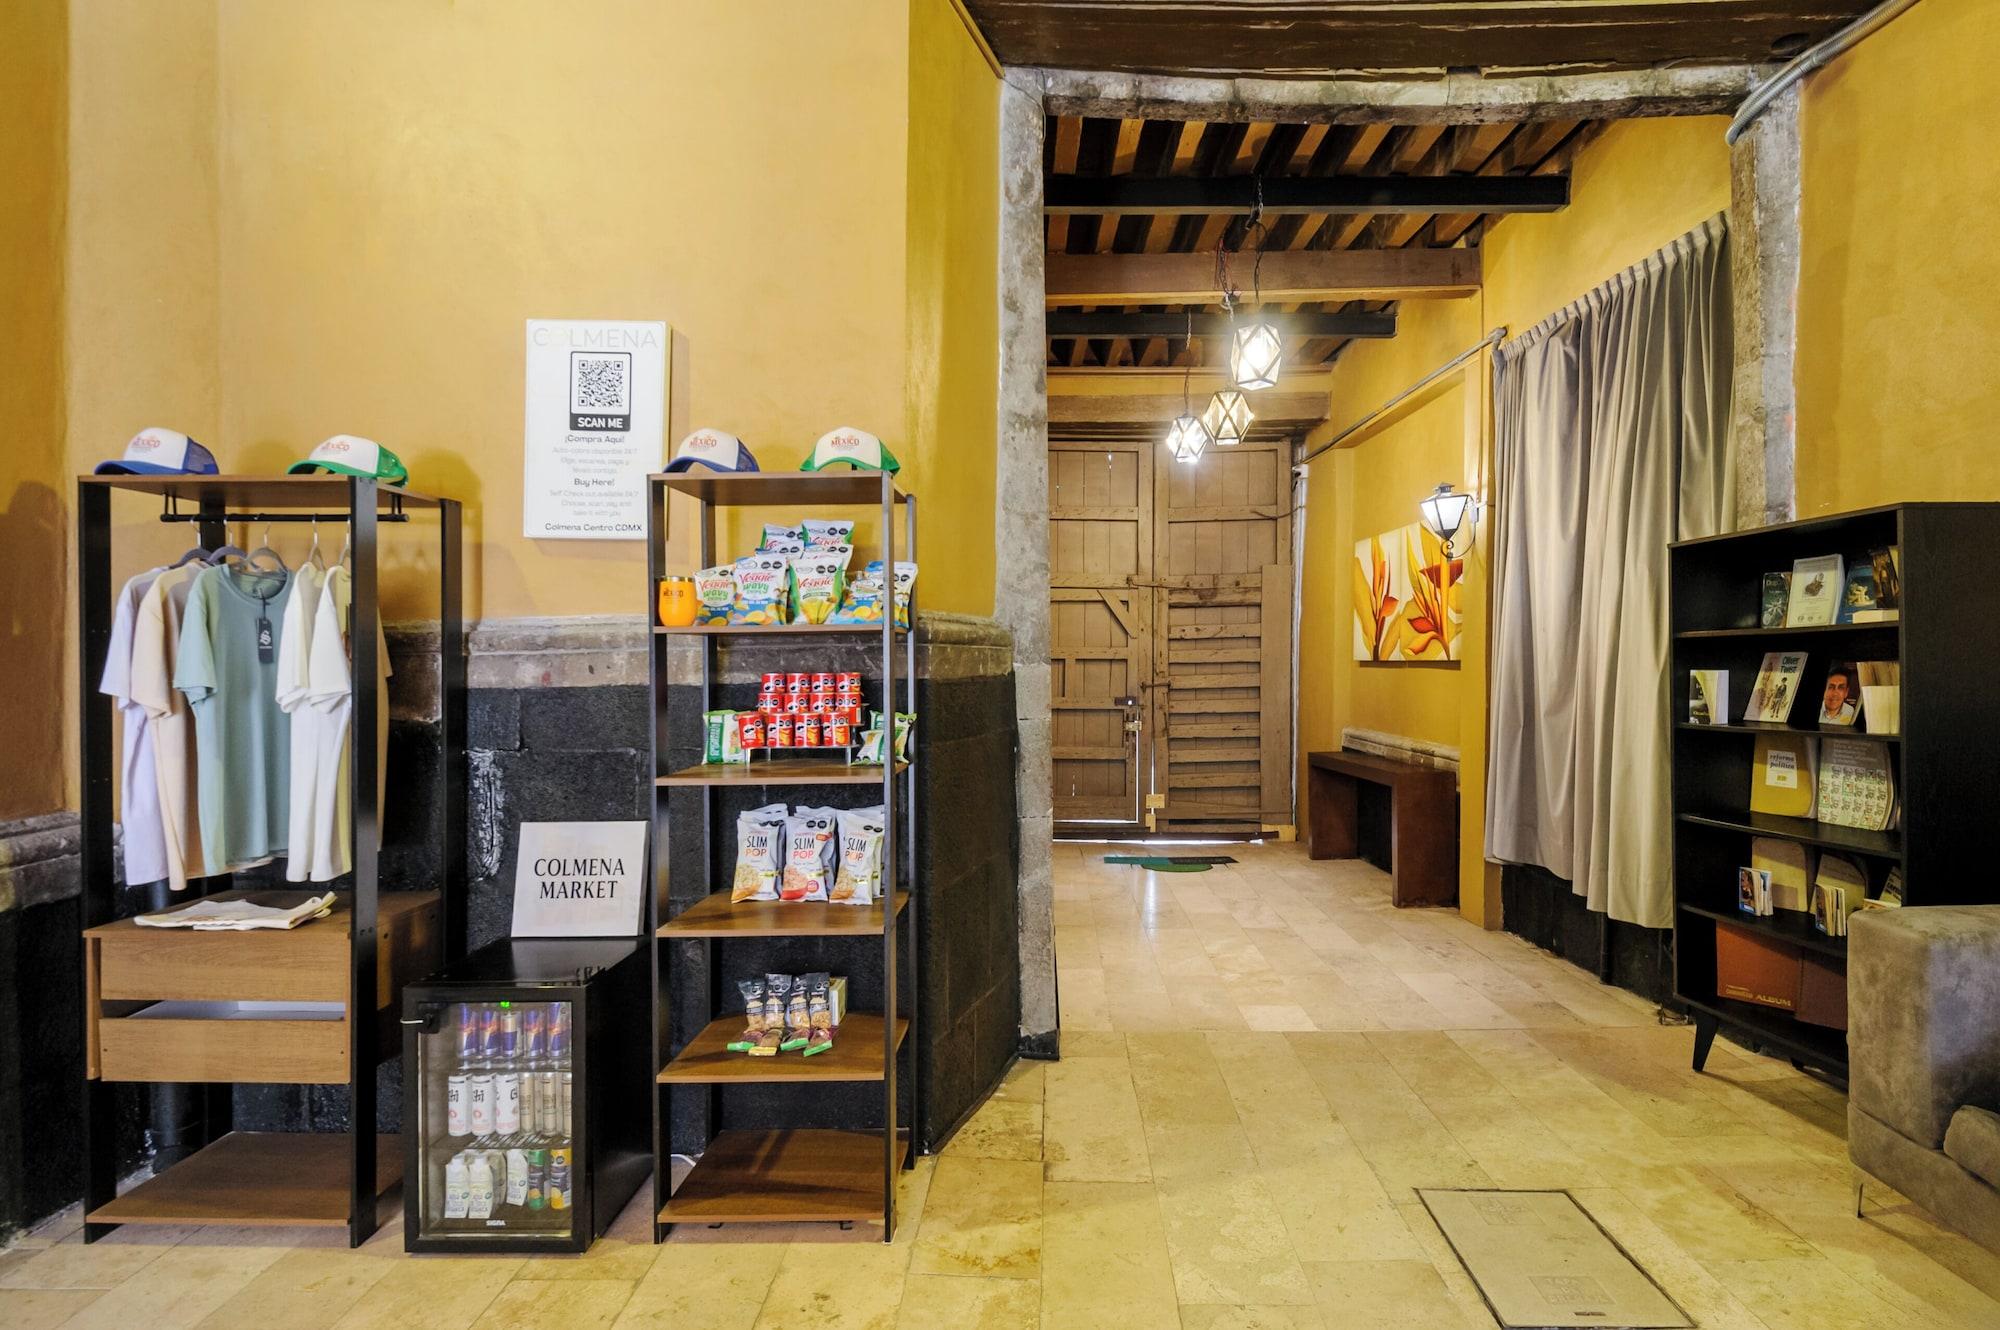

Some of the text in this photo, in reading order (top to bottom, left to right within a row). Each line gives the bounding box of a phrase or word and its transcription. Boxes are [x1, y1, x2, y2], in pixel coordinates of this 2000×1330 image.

[533, 327, 658, 349] COLMENA
[577, 417, 623, 429] SCAN ME
[564, 434, 603, 445] ¡Compra
[574, 478, 616, 488] Buy Here!
[545, 522, 643, 532] Colmena Centro CDMX
[746, 835, 768, 848] SLIM
[794, 837, 815, 850] SLIM
[846, 837, 867, 853] SLIM
[745, 848, 767, 857] POP
[792, 850, 815, 860] POP
[533, 858, 625, 877] COLMENA
[539, 880, 619, 899] MARKET
